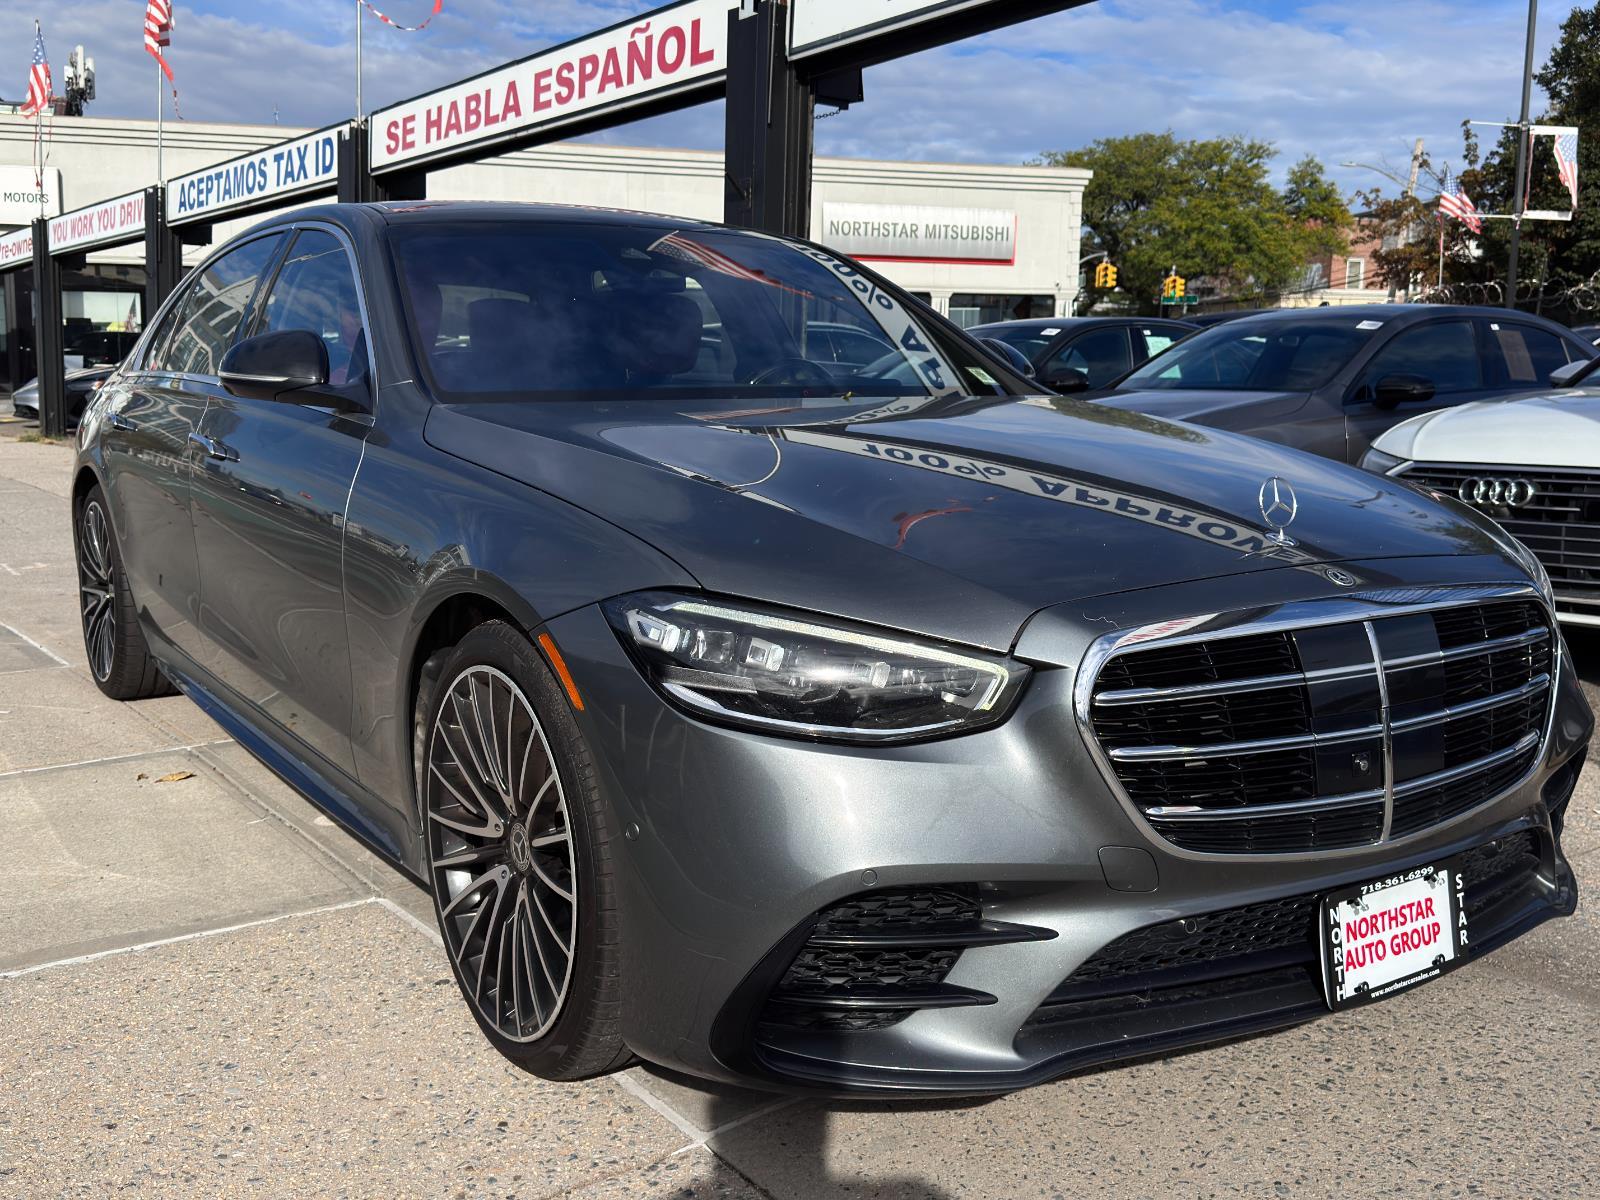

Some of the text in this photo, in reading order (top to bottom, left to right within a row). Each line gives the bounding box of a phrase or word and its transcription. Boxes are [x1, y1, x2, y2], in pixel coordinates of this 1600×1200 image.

[385, 17, 715, 156] SE HABLA ESPAÑOL
[4, 192, 49, 204] MOTORS
[178, 136, 335, 214] ACEPTAMOS TAX ID
[0, 237, 32, 260] re-owne
[52, 219, 68, 244] YOU
[70, 212, 94, 240] WORK
[97, 206, 117, 231] YOU
[829, 219, 1010, 243] NORTHSTAR MITSUBISHI
[1360, 866, 1434, 895] 718-361-6299
[1345, 897, 1436, 944] NORTHSTAR
[1455, 873, 1469, 946] STAR
[1329, 908, 1347, 1002] NORTH
[1345, 921, 1441, 973] AUTO GROUP
